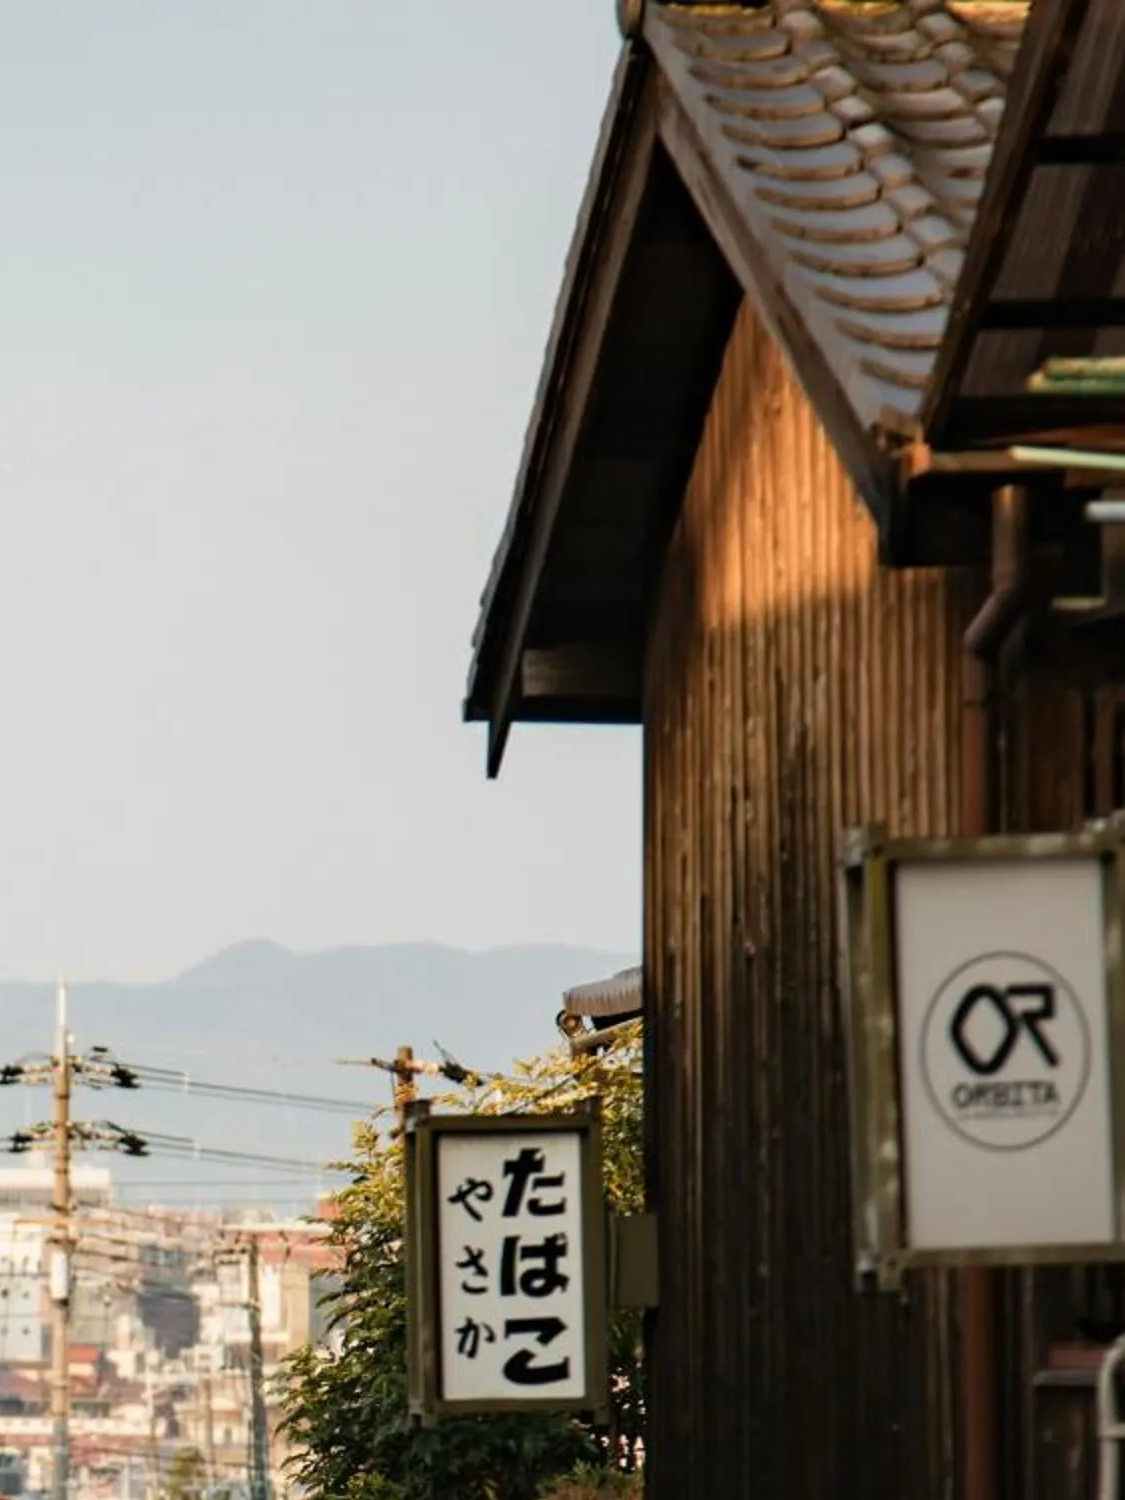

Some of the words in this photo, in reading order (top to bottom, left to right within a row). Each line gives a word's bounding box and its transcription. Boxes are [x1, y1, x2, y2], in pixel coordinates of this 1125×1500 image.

[447, 1176, 497, 1360] やさか
[500, 1147, 571, 1385] たばこ
